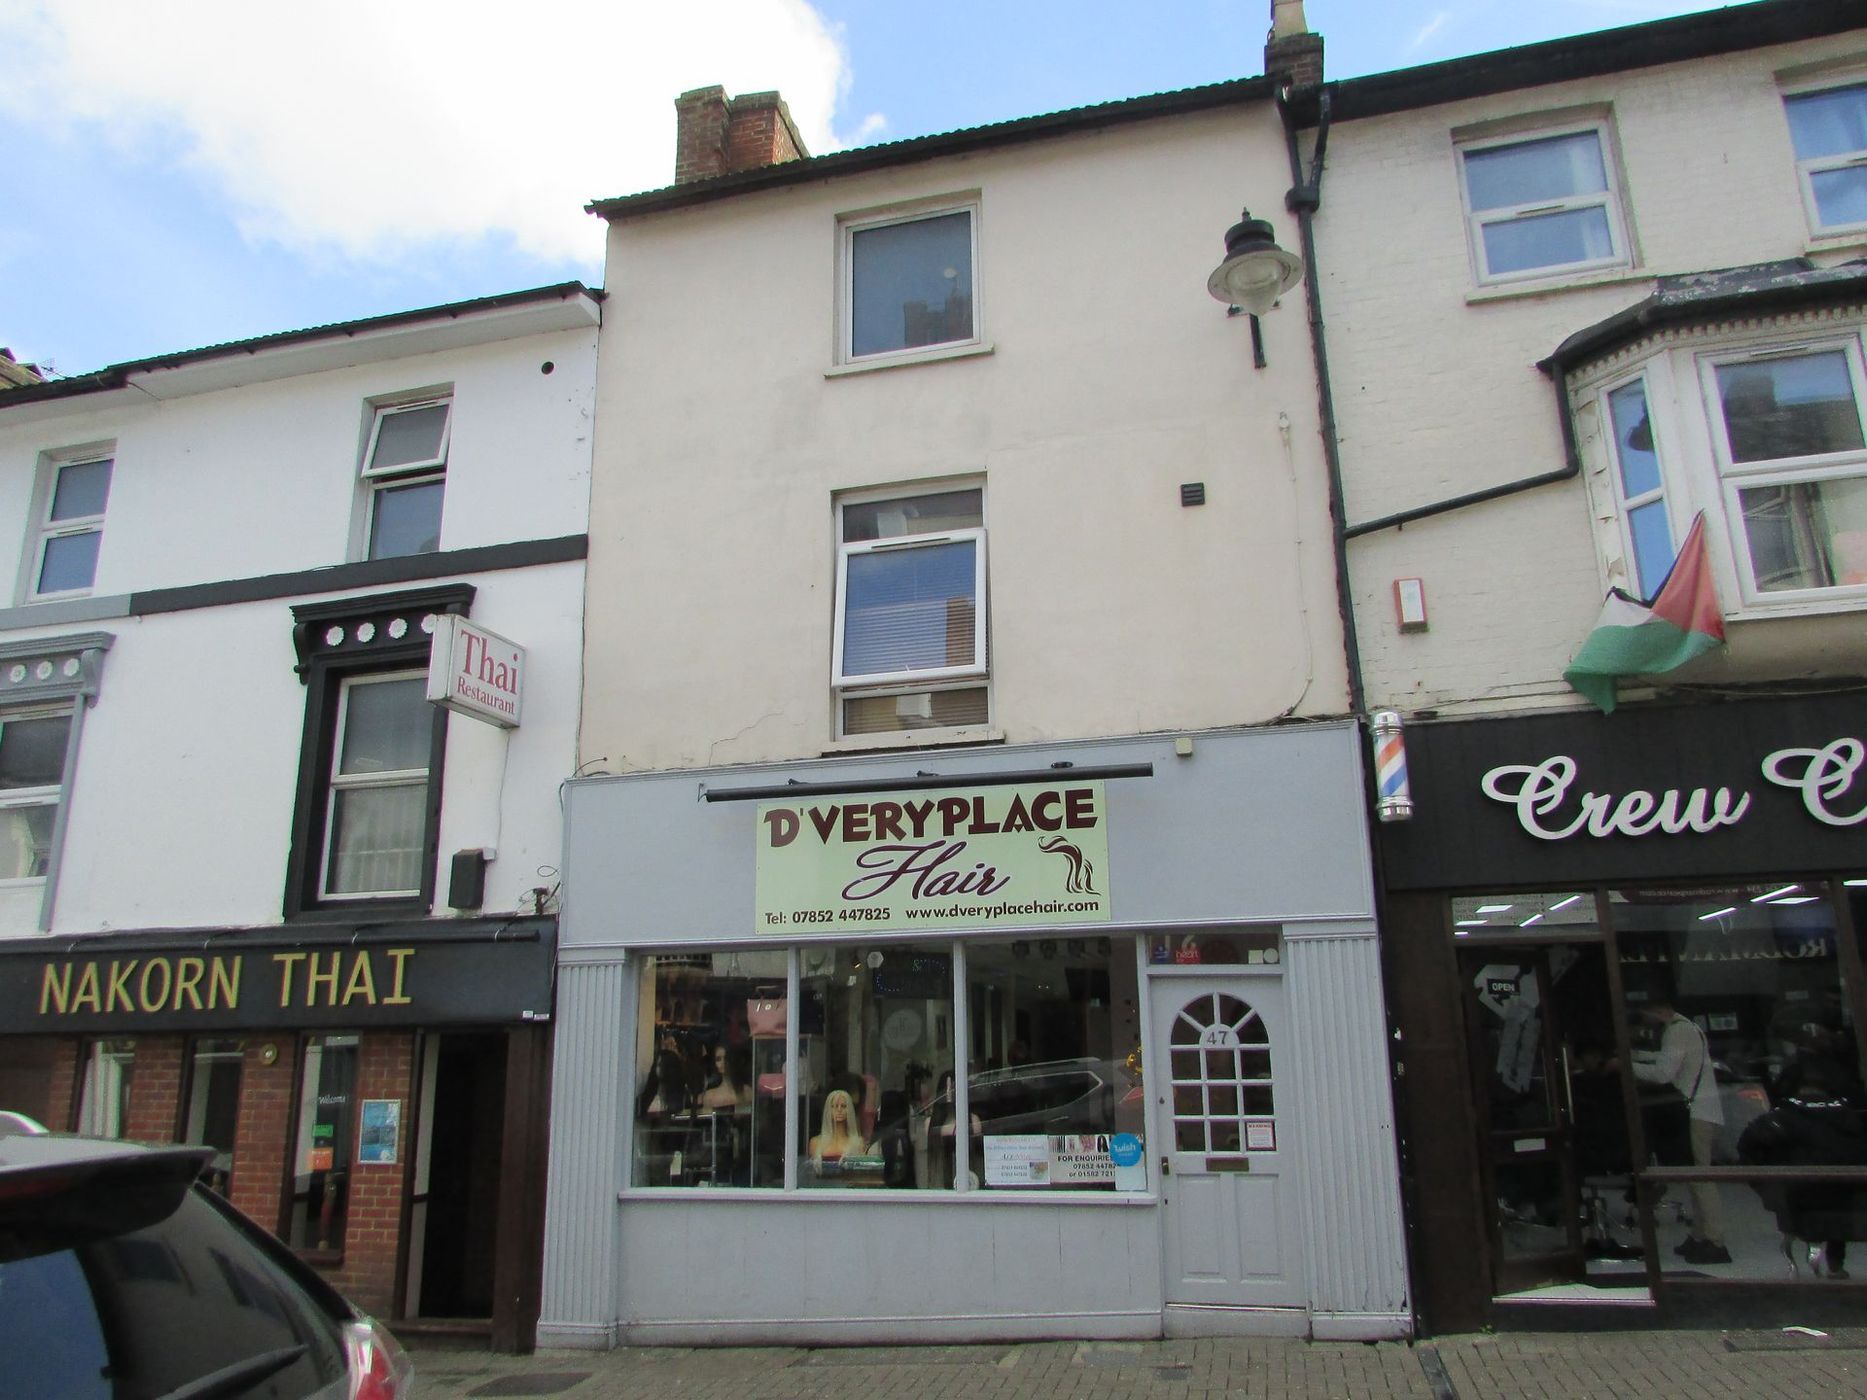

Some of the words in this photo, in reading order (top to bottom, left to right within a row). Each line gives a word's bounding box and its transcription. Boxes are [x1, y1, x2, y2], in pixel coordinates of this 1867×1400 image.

[460, 628, 519, 695] Thai
[456, 676, 516, 715] Restaurant
[763, 788, 1099, 848] D'VERYPLACE
[1481, 755, 1750, 840] Crew
[841, 840, 1011, 901] Hair
[765, 911, 788, 925] Tel:
[792, 909, 834, 924] 07852
[838, 906, 891, 922] 447825
[905, 899, 1099, 921] www.dveryplacehair.com
[39, 954, 243, 1015] NAKORN
[273, 948, 417, 1007] THAI
[1491, 982, 1516, 992] OPEN
[1206, 1030, 1228, 1046] 47
